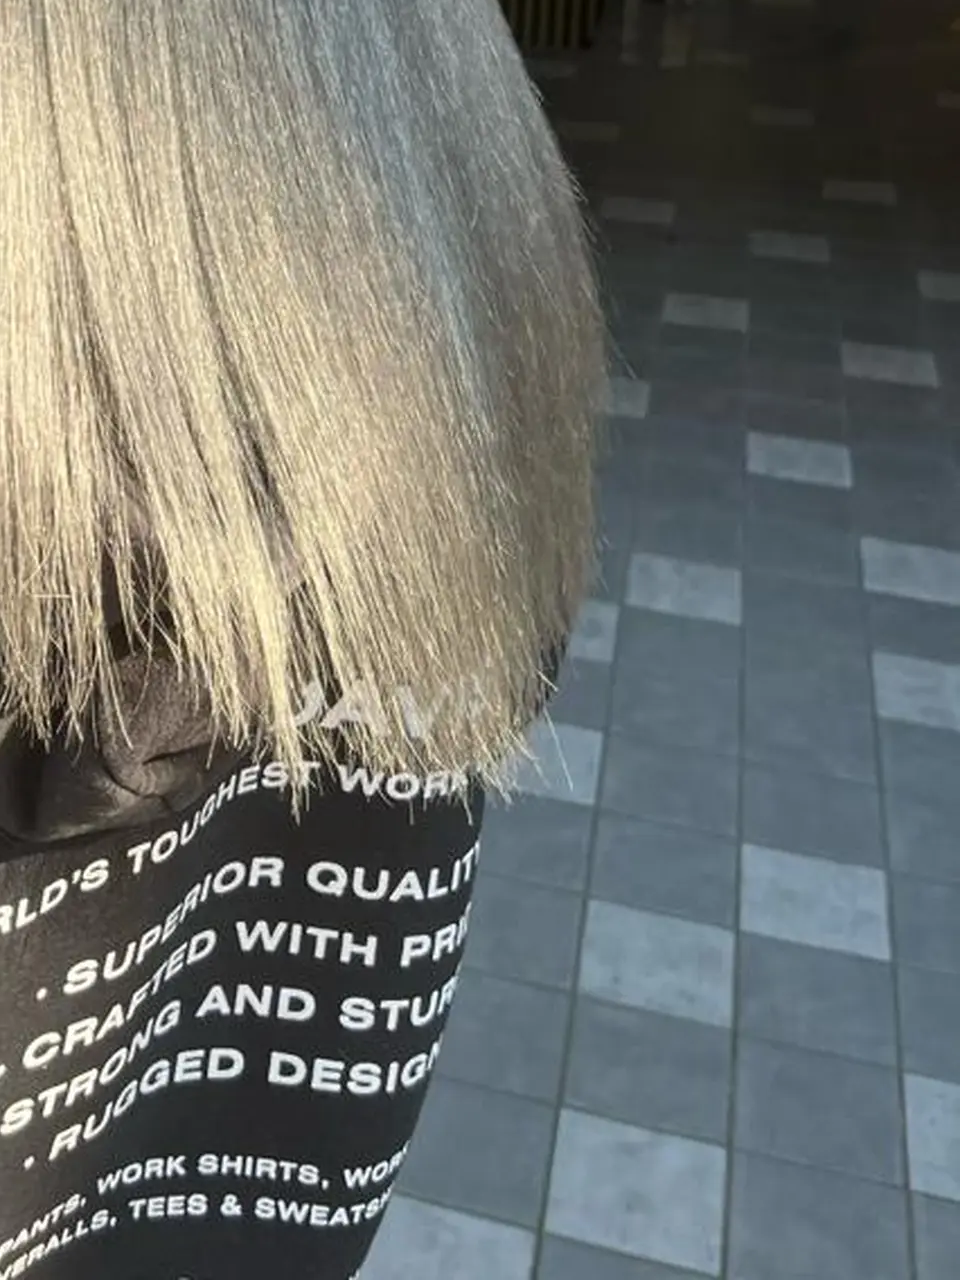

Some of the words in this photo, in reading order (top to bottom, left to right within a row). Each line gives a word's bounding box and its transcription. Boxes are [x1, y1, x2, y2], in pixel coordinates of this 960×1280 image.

[127, 761, 321, 874] TOUGHEST
[339, 766, 470, 800] WOR
[63, 856, 285, 995] SUPERIOR
[22, 929, 217, 1069] CRAFTED
[236, 920, 377, 966] WITH
[0, 1000, 181, 1136] STRONG
[195, 984, 316, 1021] AND
[339, 968, 459, 1031] STUR
[49, 1047, 245, 1161] RUGGED
[97, 1155, 186, 1195] WORK
[197, 1153, 329, 1189] SHIRTS,
[343, 1140, 410, 1189] WOR
[128, 1193, 208, 1220] TEES
[220, 1194, 242, 1216] &
